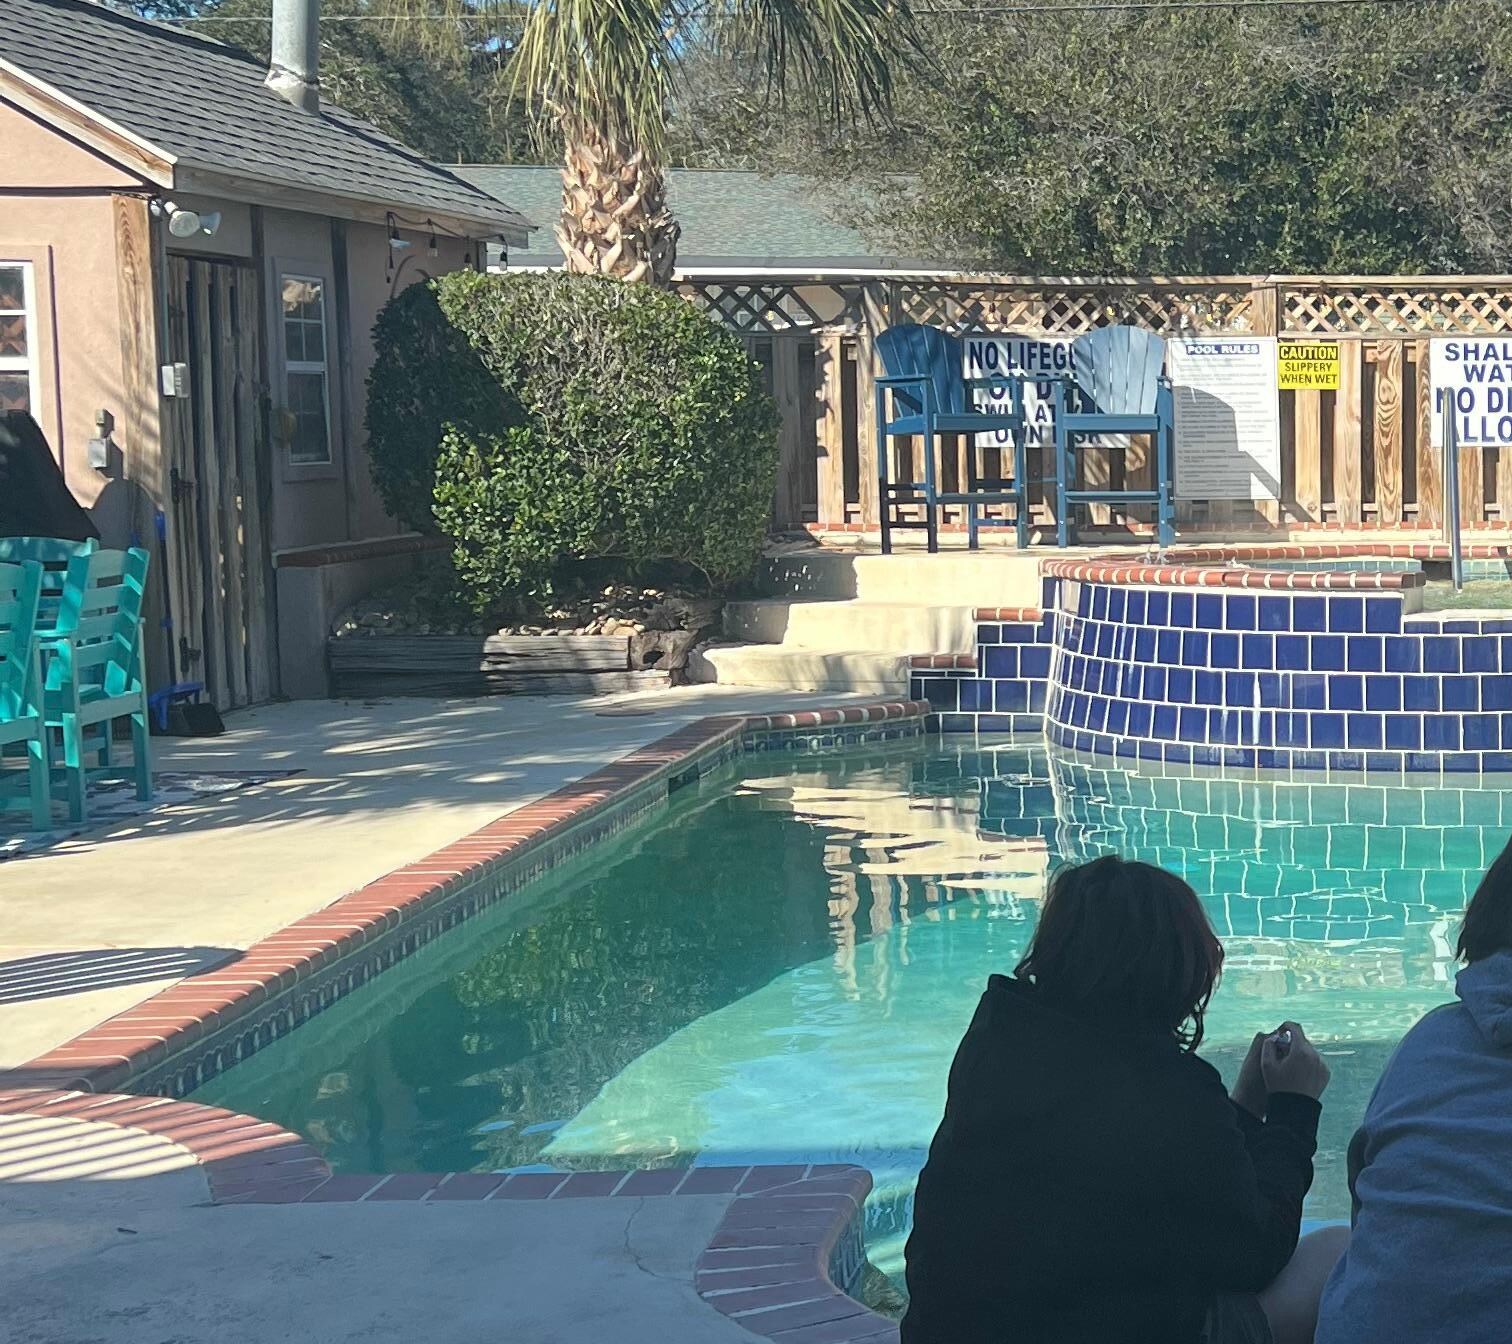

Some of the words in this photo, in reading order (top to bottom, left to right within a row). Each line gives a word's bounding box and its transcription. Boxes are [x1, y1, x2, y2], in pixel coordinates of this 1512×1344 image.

[1187, 344, 1218, 355] POOL
[1221, 344, 1259, 354] RULES
[1280, 346, 1338, 360] CAUTION
[969, 341, 999, 370] NO
[1008, 341, 1077, 370] LIFEG
[1284, 362, 1333, 373] SLIPPERY
[1280, 374, 1312, 384] WHEN
[1314, 373, 1338, 384] WET
